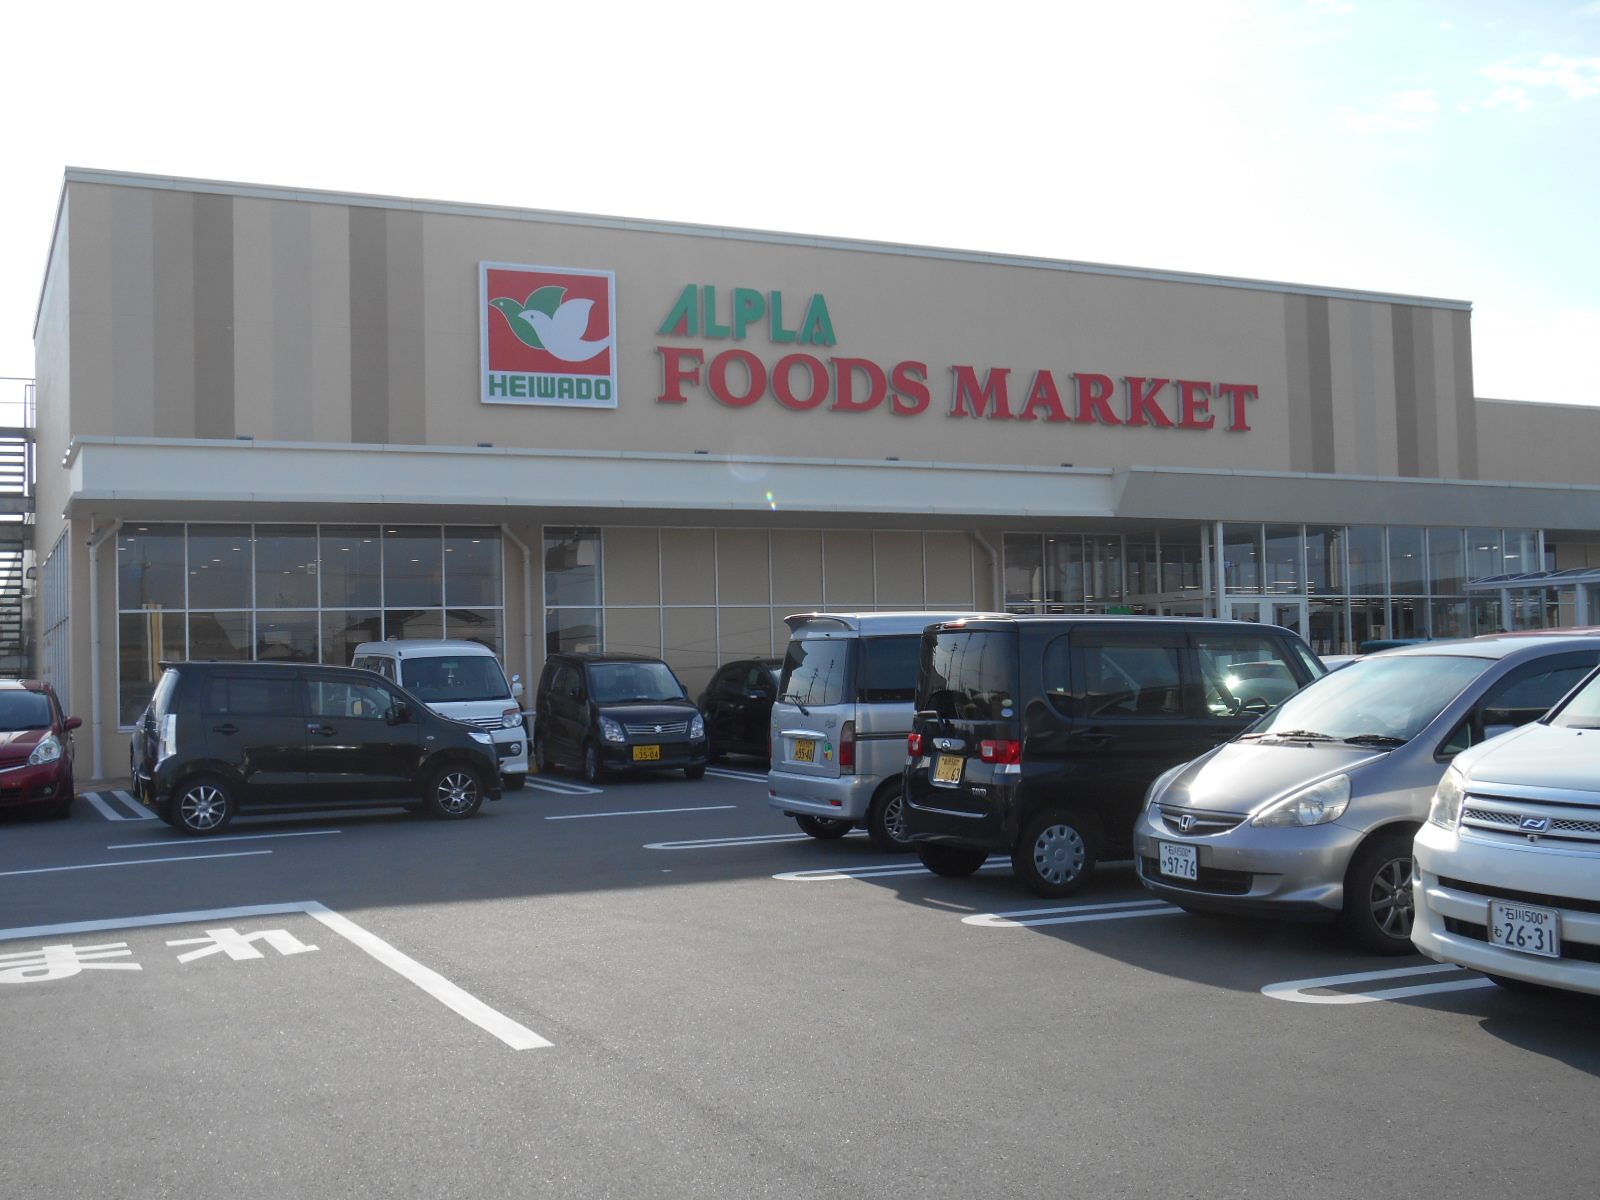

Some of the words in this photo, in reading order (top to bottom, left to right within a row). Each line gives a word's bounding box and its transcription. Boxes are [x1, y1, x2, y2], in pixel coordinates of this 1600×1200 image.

[656, 283, 837, 346] ALPLA
[489, 374, 611, 400] HEIWADO
[655, 346, 931, 416] FOODS
[946, 365, 1259, 431] MARKET
[1504, 907, 1543, 925] 石川500
